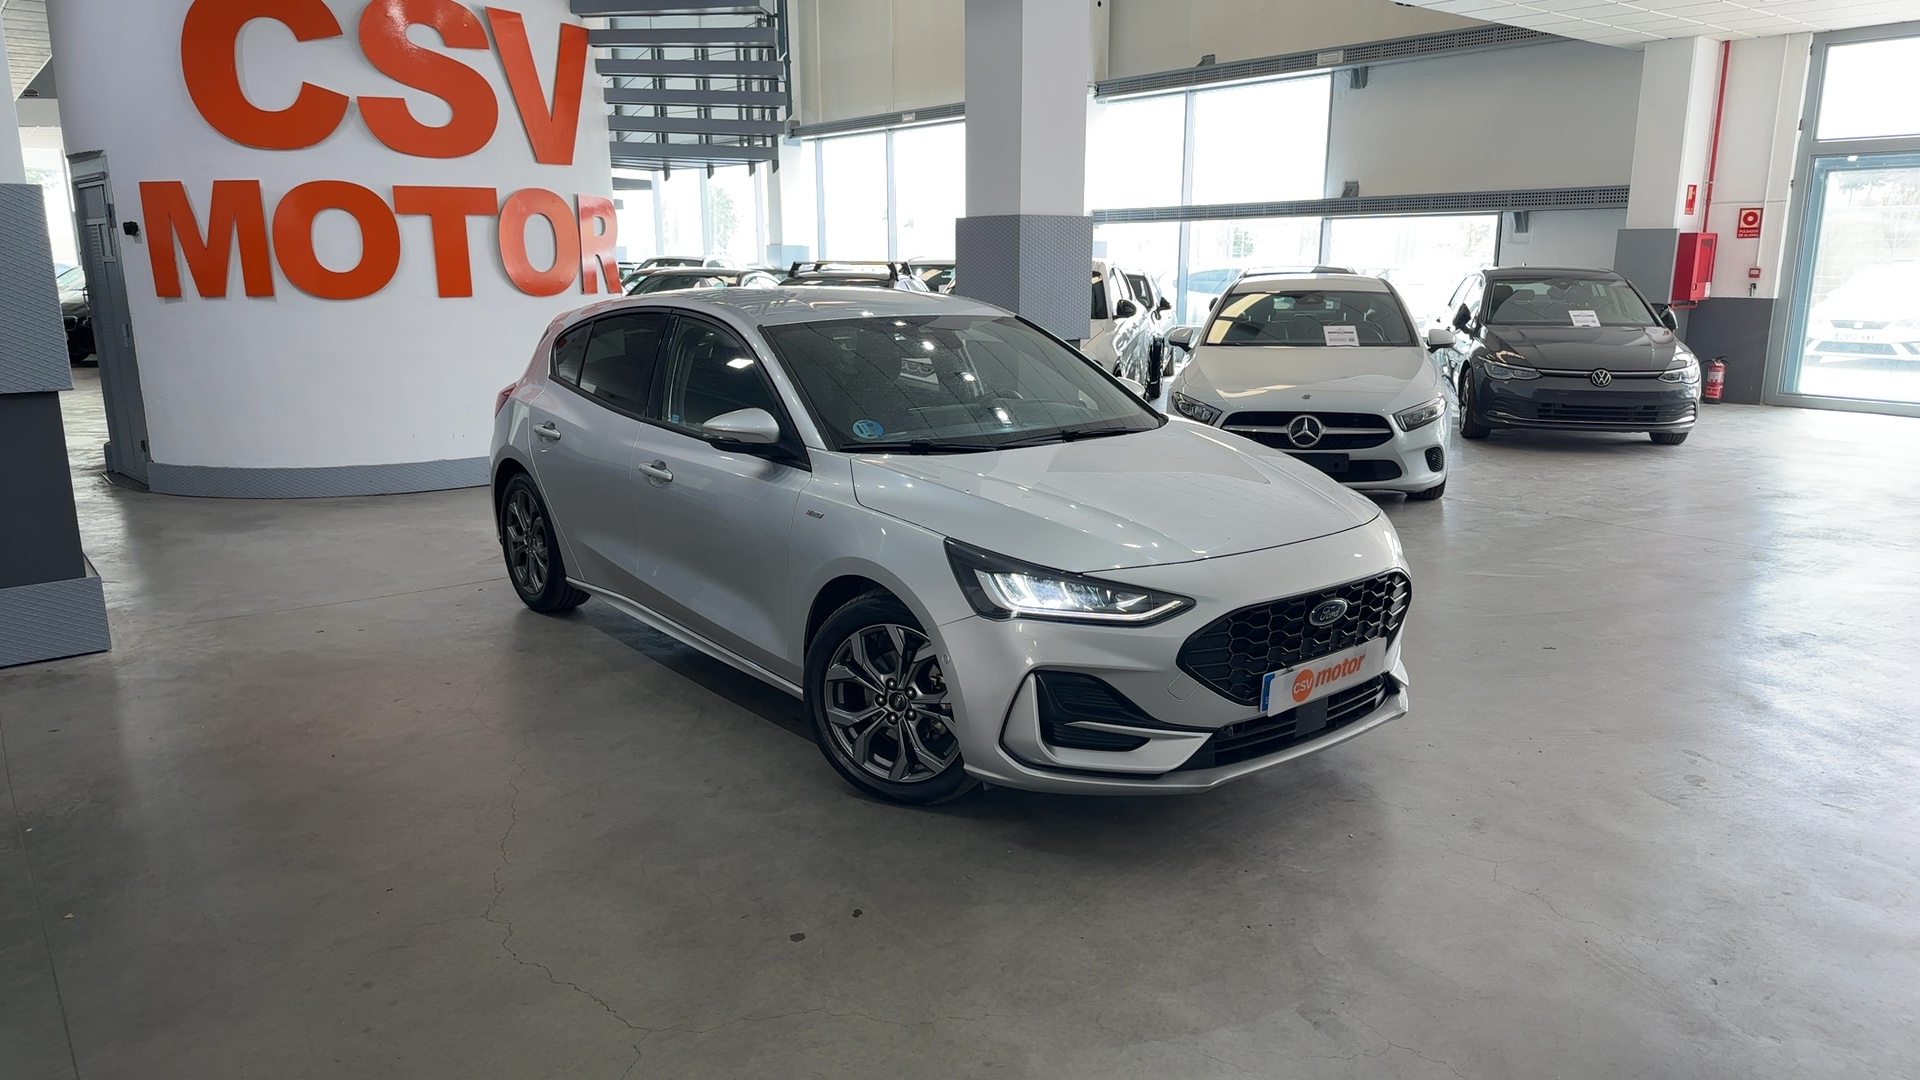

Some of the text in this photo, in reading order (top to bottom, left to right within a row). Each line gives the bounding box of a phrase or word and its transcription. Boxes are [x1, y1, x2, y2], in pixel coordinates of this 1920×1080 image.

[181, 0, 590, 166] CSV
[138, 179, 623, 299] MOTOR
[1320, 605, 1340, 620] Ford
[1314, 653, 1366, 688] motor
